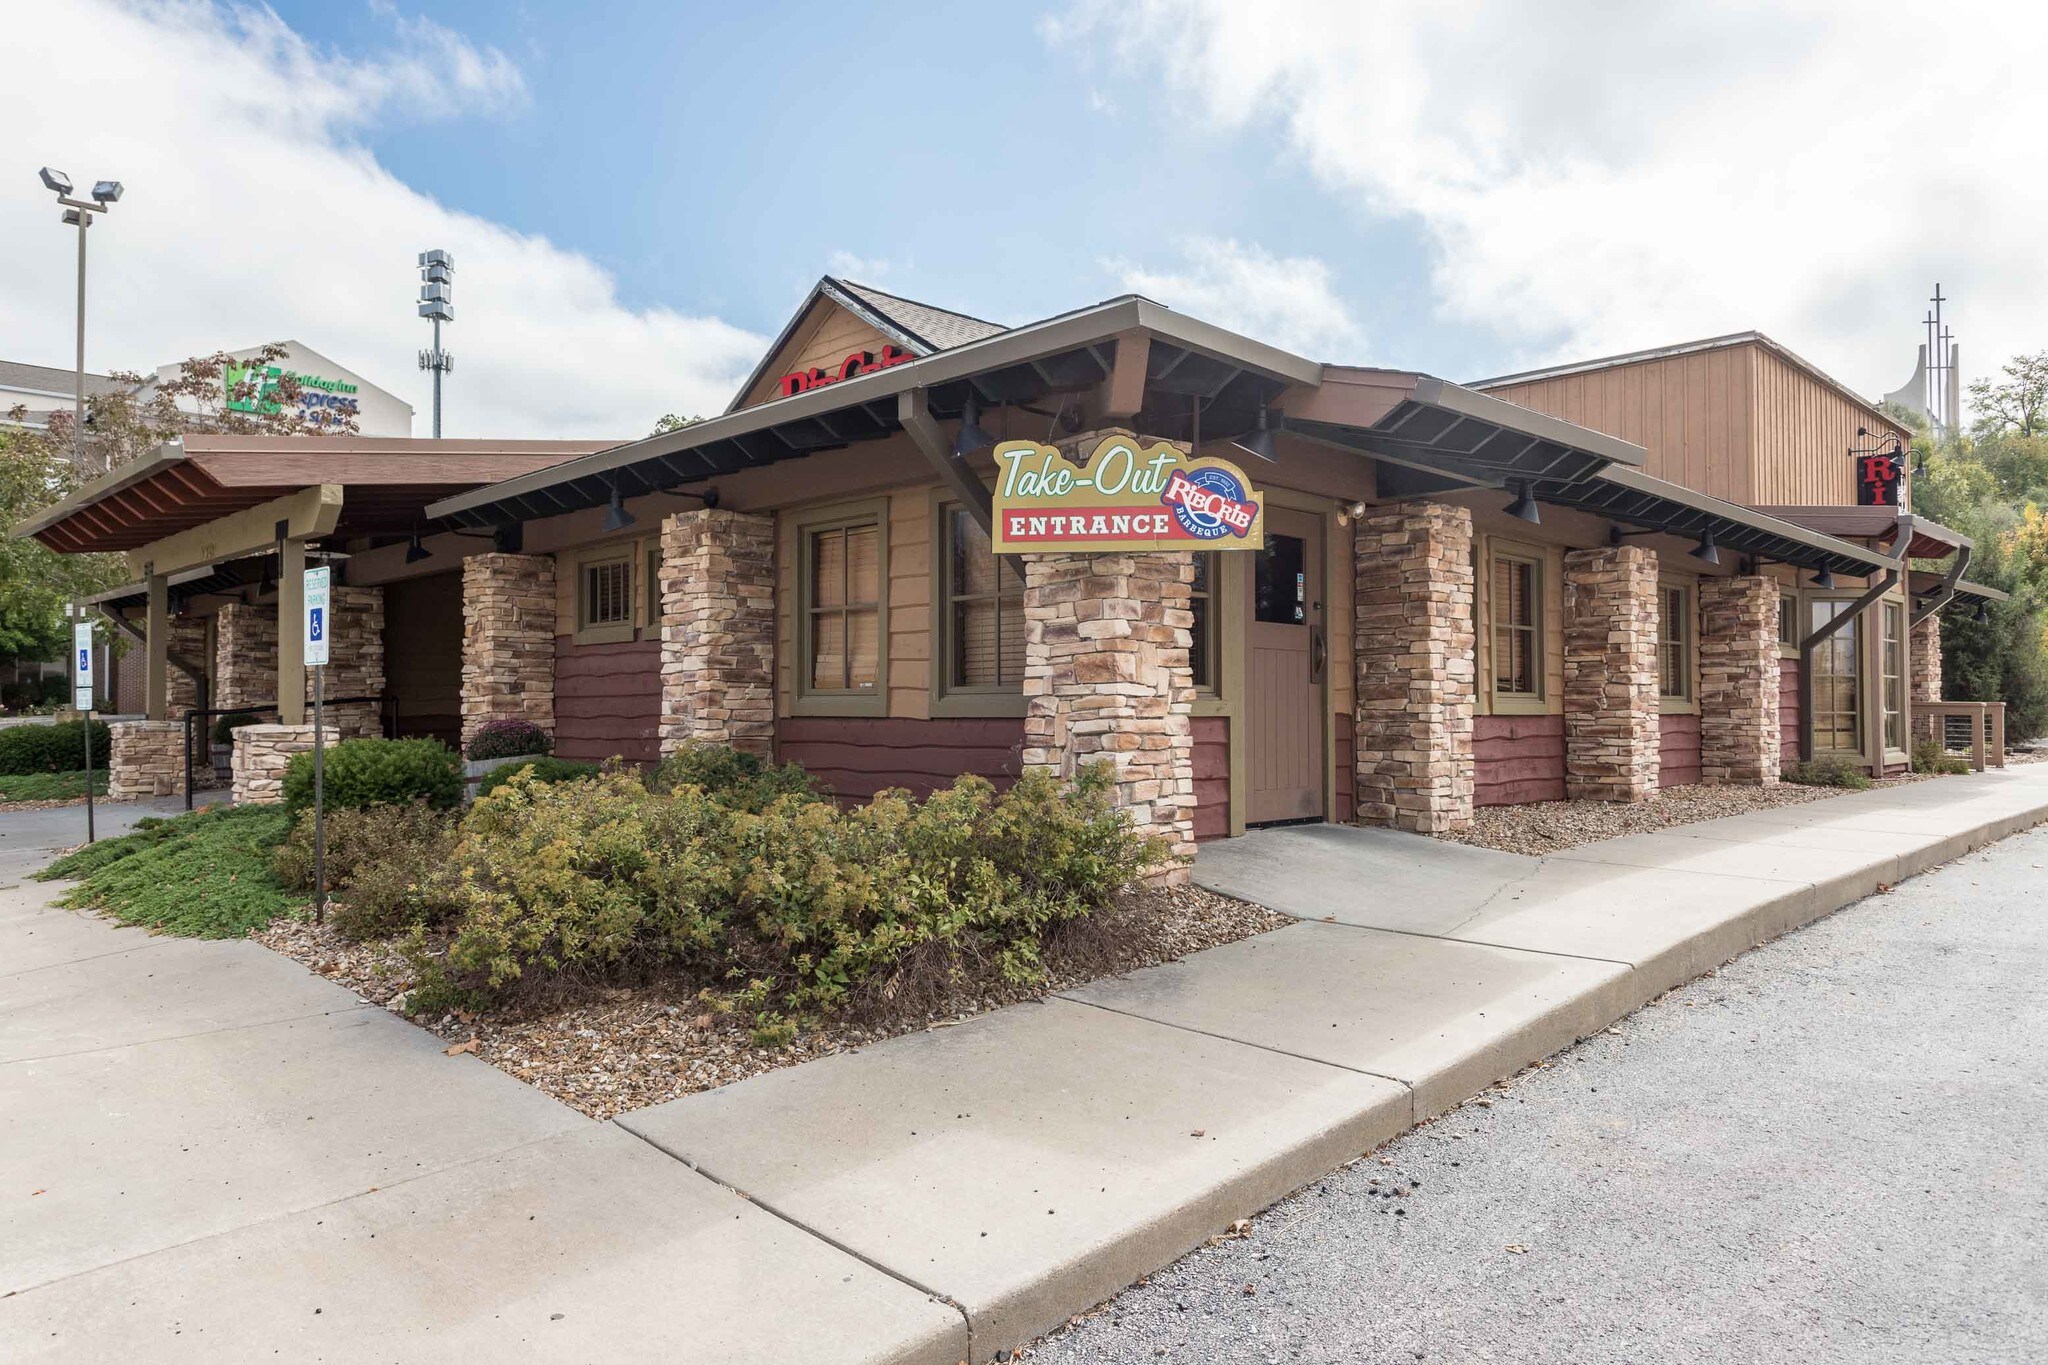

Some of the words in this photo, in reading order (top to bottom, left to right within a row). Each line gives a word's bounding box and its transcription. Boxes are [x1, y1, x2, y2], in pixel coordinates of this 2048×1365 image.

[286, 371, 336, 393] oliday
[300, 391, 358, 412] xpress
[1004, 445, 1177, 498] Take-Out
[1010, 514, 1169, 536] ENTRANCE
[1176, 506, 1228, 537] BARBEQUE
